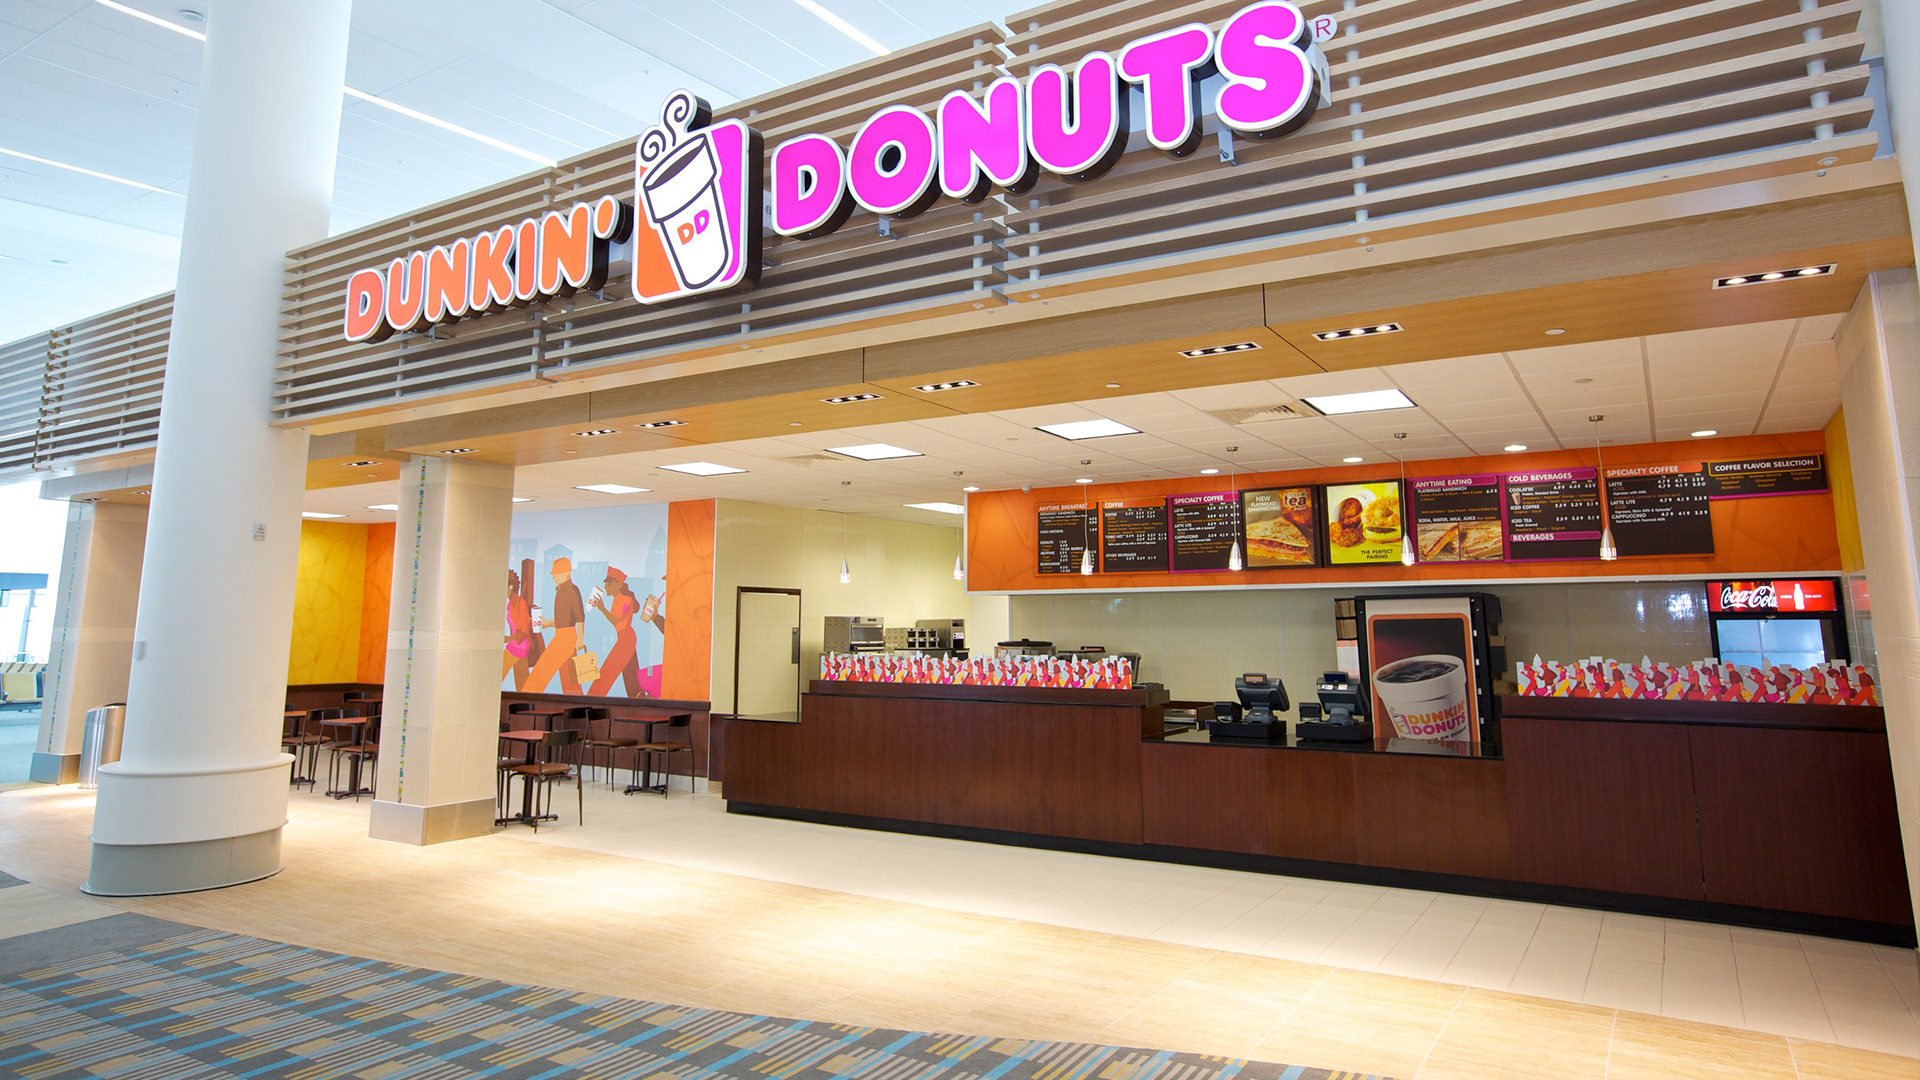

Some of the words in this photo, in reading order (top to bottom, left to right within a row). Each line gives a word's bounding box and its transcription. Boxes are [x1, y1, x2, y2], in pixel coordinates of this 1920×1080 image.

[772, 0, 1312, 237] DONUTS
[677, 209, 710, 245] DD
[345, 195, 619, 342] DUNKIN'
[1607, 468, 1647, 477] SPECIALTY
[1649, 466, 1679, 474] COFFEE
[1715, 464, 1741, 472] COFFEE
[1743, 462, 1772, 470] FLAVOR
[1773, 459, 1814, 468] SELECTION
[1530, 472, 1572, 481] BEVERAGES
[1416, 480, 1446, 488] ANYTIME
[1284, 495, 1306, 506] tea
[1513, 534, 1554, 542] BEVERAGES
[1721, 586, 1778, 609] Coca-Cola
[1411, 712, 1466, 735] DONUTS
